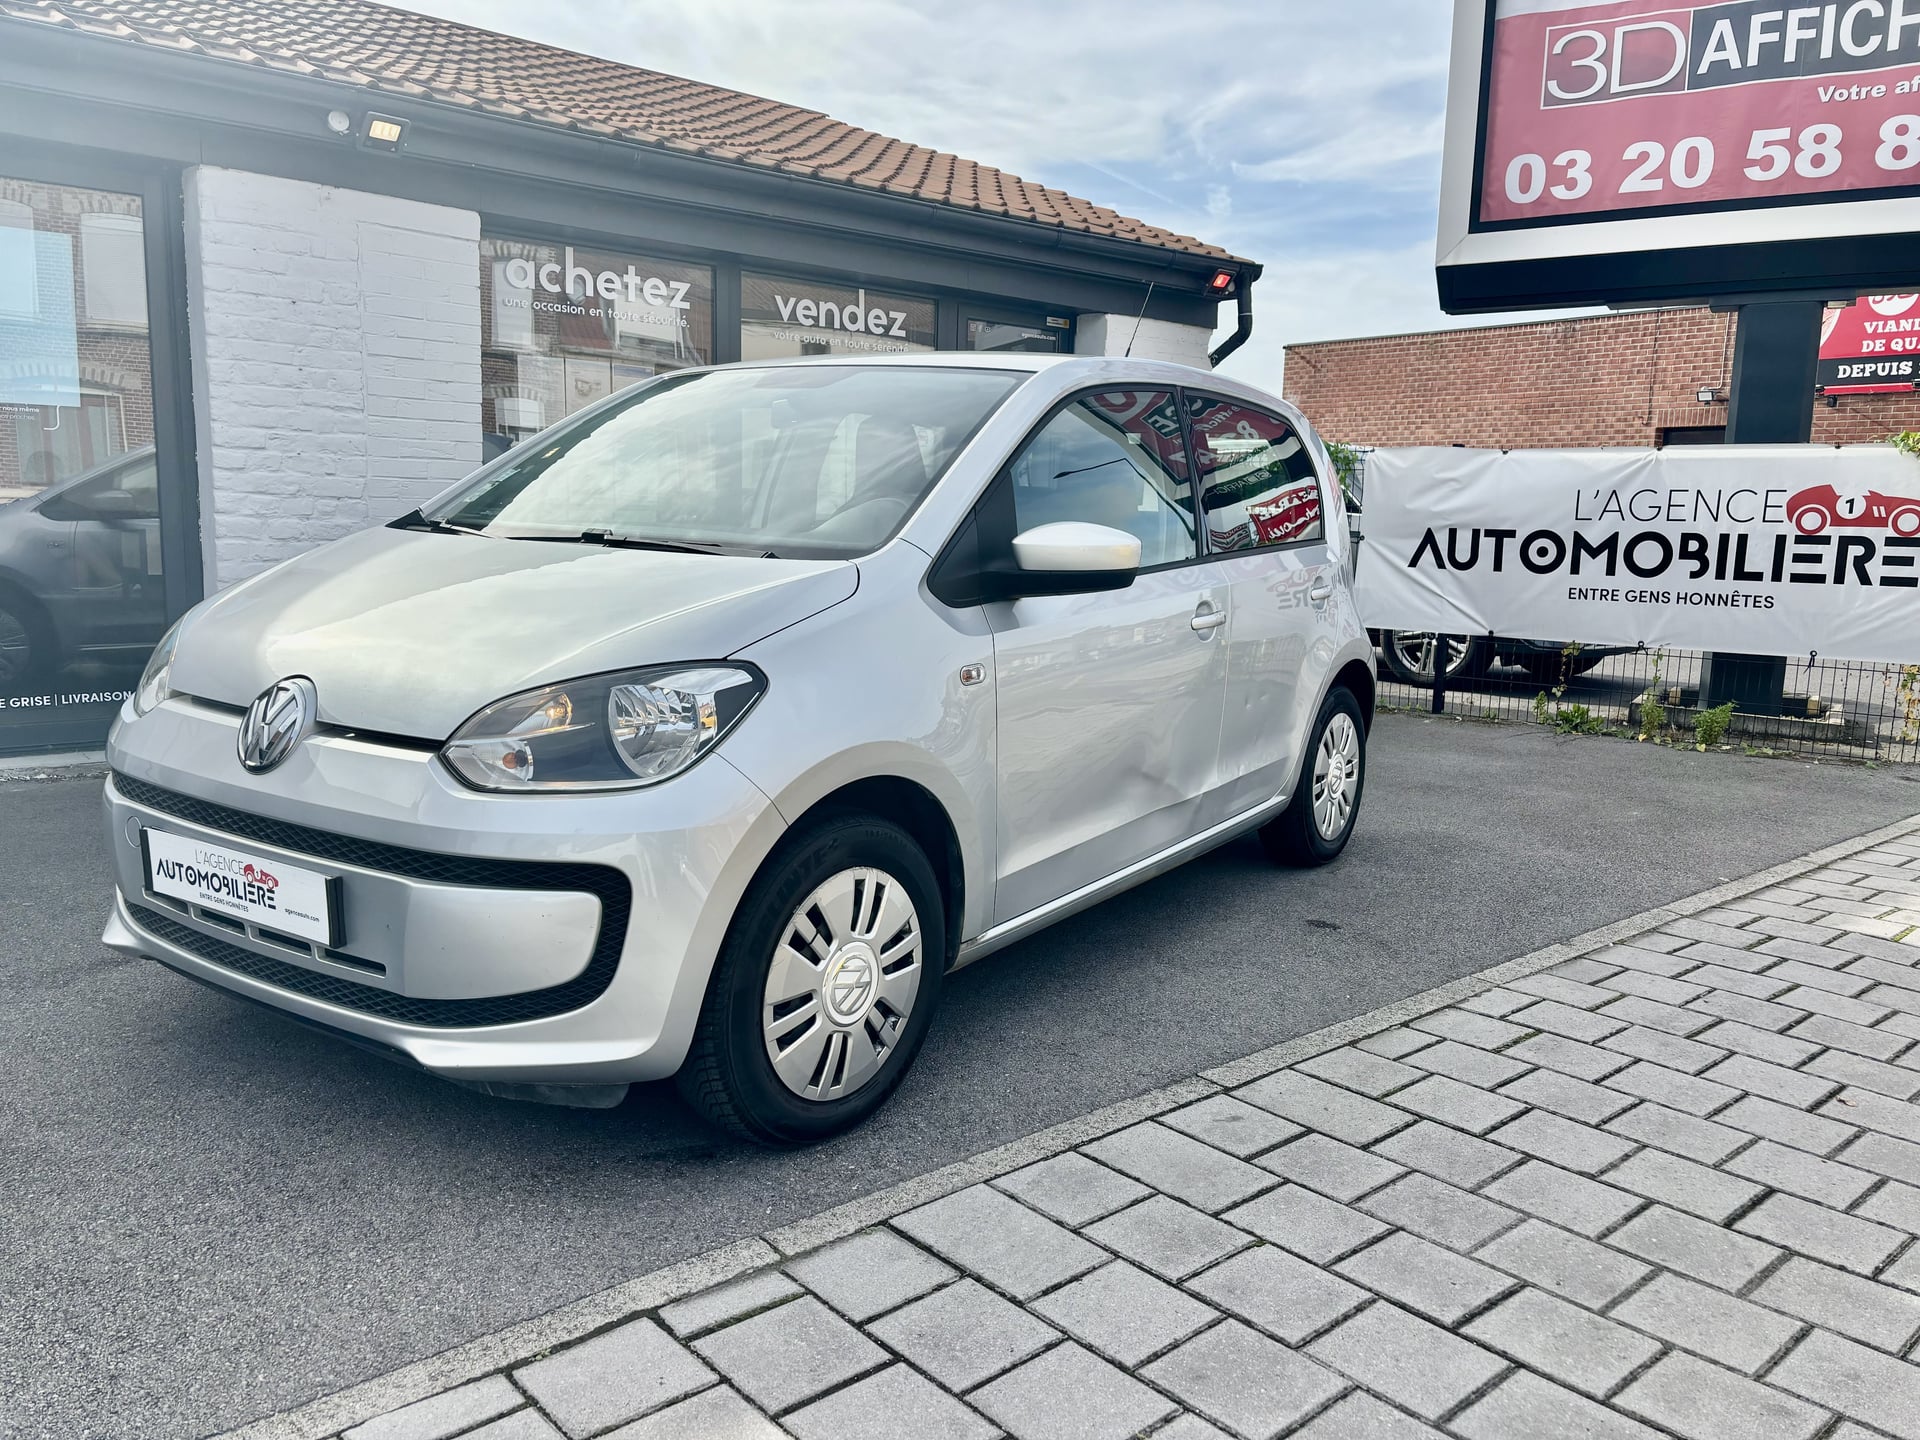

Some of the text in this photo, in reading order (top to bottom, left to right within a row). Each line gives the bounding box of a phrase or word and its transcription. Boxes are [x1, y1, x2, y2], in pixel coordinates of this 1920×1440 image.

[1547, 0, 1920, 100] 3D AFFICH
[1817, 82, 1887, 103] Votre
[1505, 114, 1920, 204] 03 20 58 8
[505, 246, 691, 310] achetez
[505, 297, 529, 308] une
[533, 301, 586, 316] occasion
[589, 308, 604, 318] en
[608, 309, 640, 322] toute
[774, 288, 907, 338] vendez
[774, 331, 800, 340] votre
[803, 334, 827, 345] auto
[830, 338, 841, 346] en
[844, 339, 870, 350] toute
[1861, 337, 1920, 353] DE QU
[1837, 361, 1913, 379] DEPUIS
[1574, 489, 1787, 524] L'AGENCE
[1845, 497, 1855, 515] 1
[1407, 527, 1920, 588] AUTOMOBILIERE
[1568, 587, 1775, 609] ENTRE GENS HONNÊTES
[9, 695, 51, 708] GRISE
[61, 690, 132, 705] LIVRAISON
[195, 848, 244, 876] L'AGENCE
[156, 857, 277, 910] AUTOMOBILIERE
[200, 891, 213, 902] ENTRE
[214, 895, 226, 905] GENS
